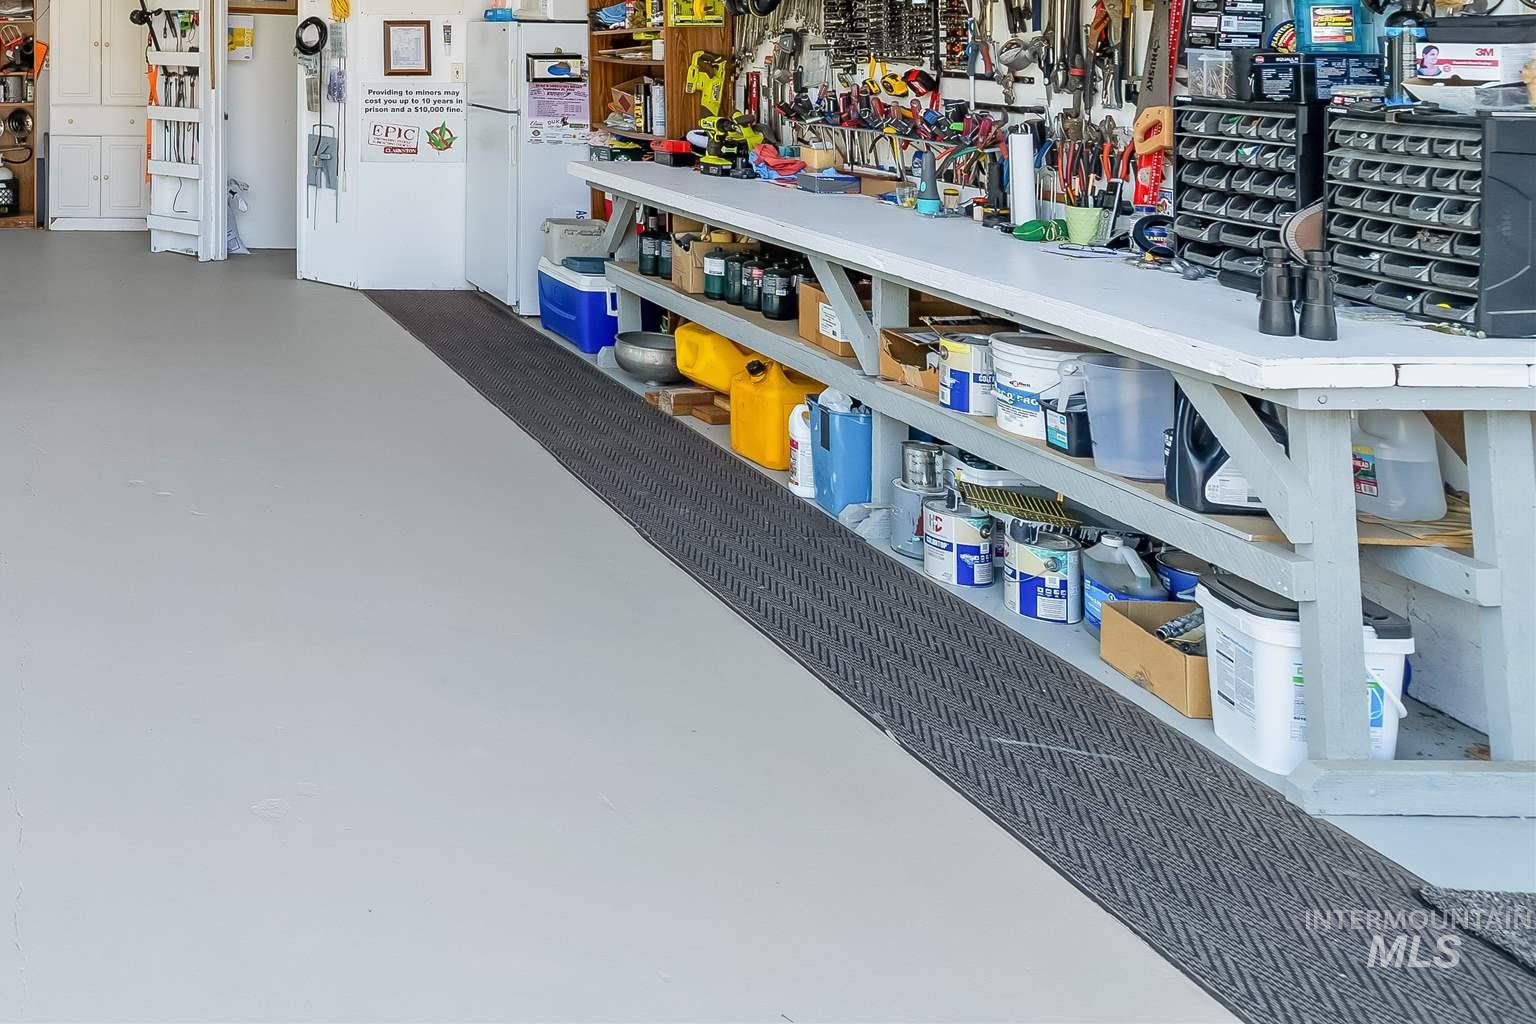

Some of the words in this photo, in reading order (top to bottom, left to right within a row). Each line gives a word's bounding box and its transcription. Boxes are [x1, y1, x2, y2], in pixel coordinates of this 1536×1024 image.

[1475, 47, 1494, 57] 3M
[364, 106, 388, 114] prison
[372, 124, 416, 141] EPIC
